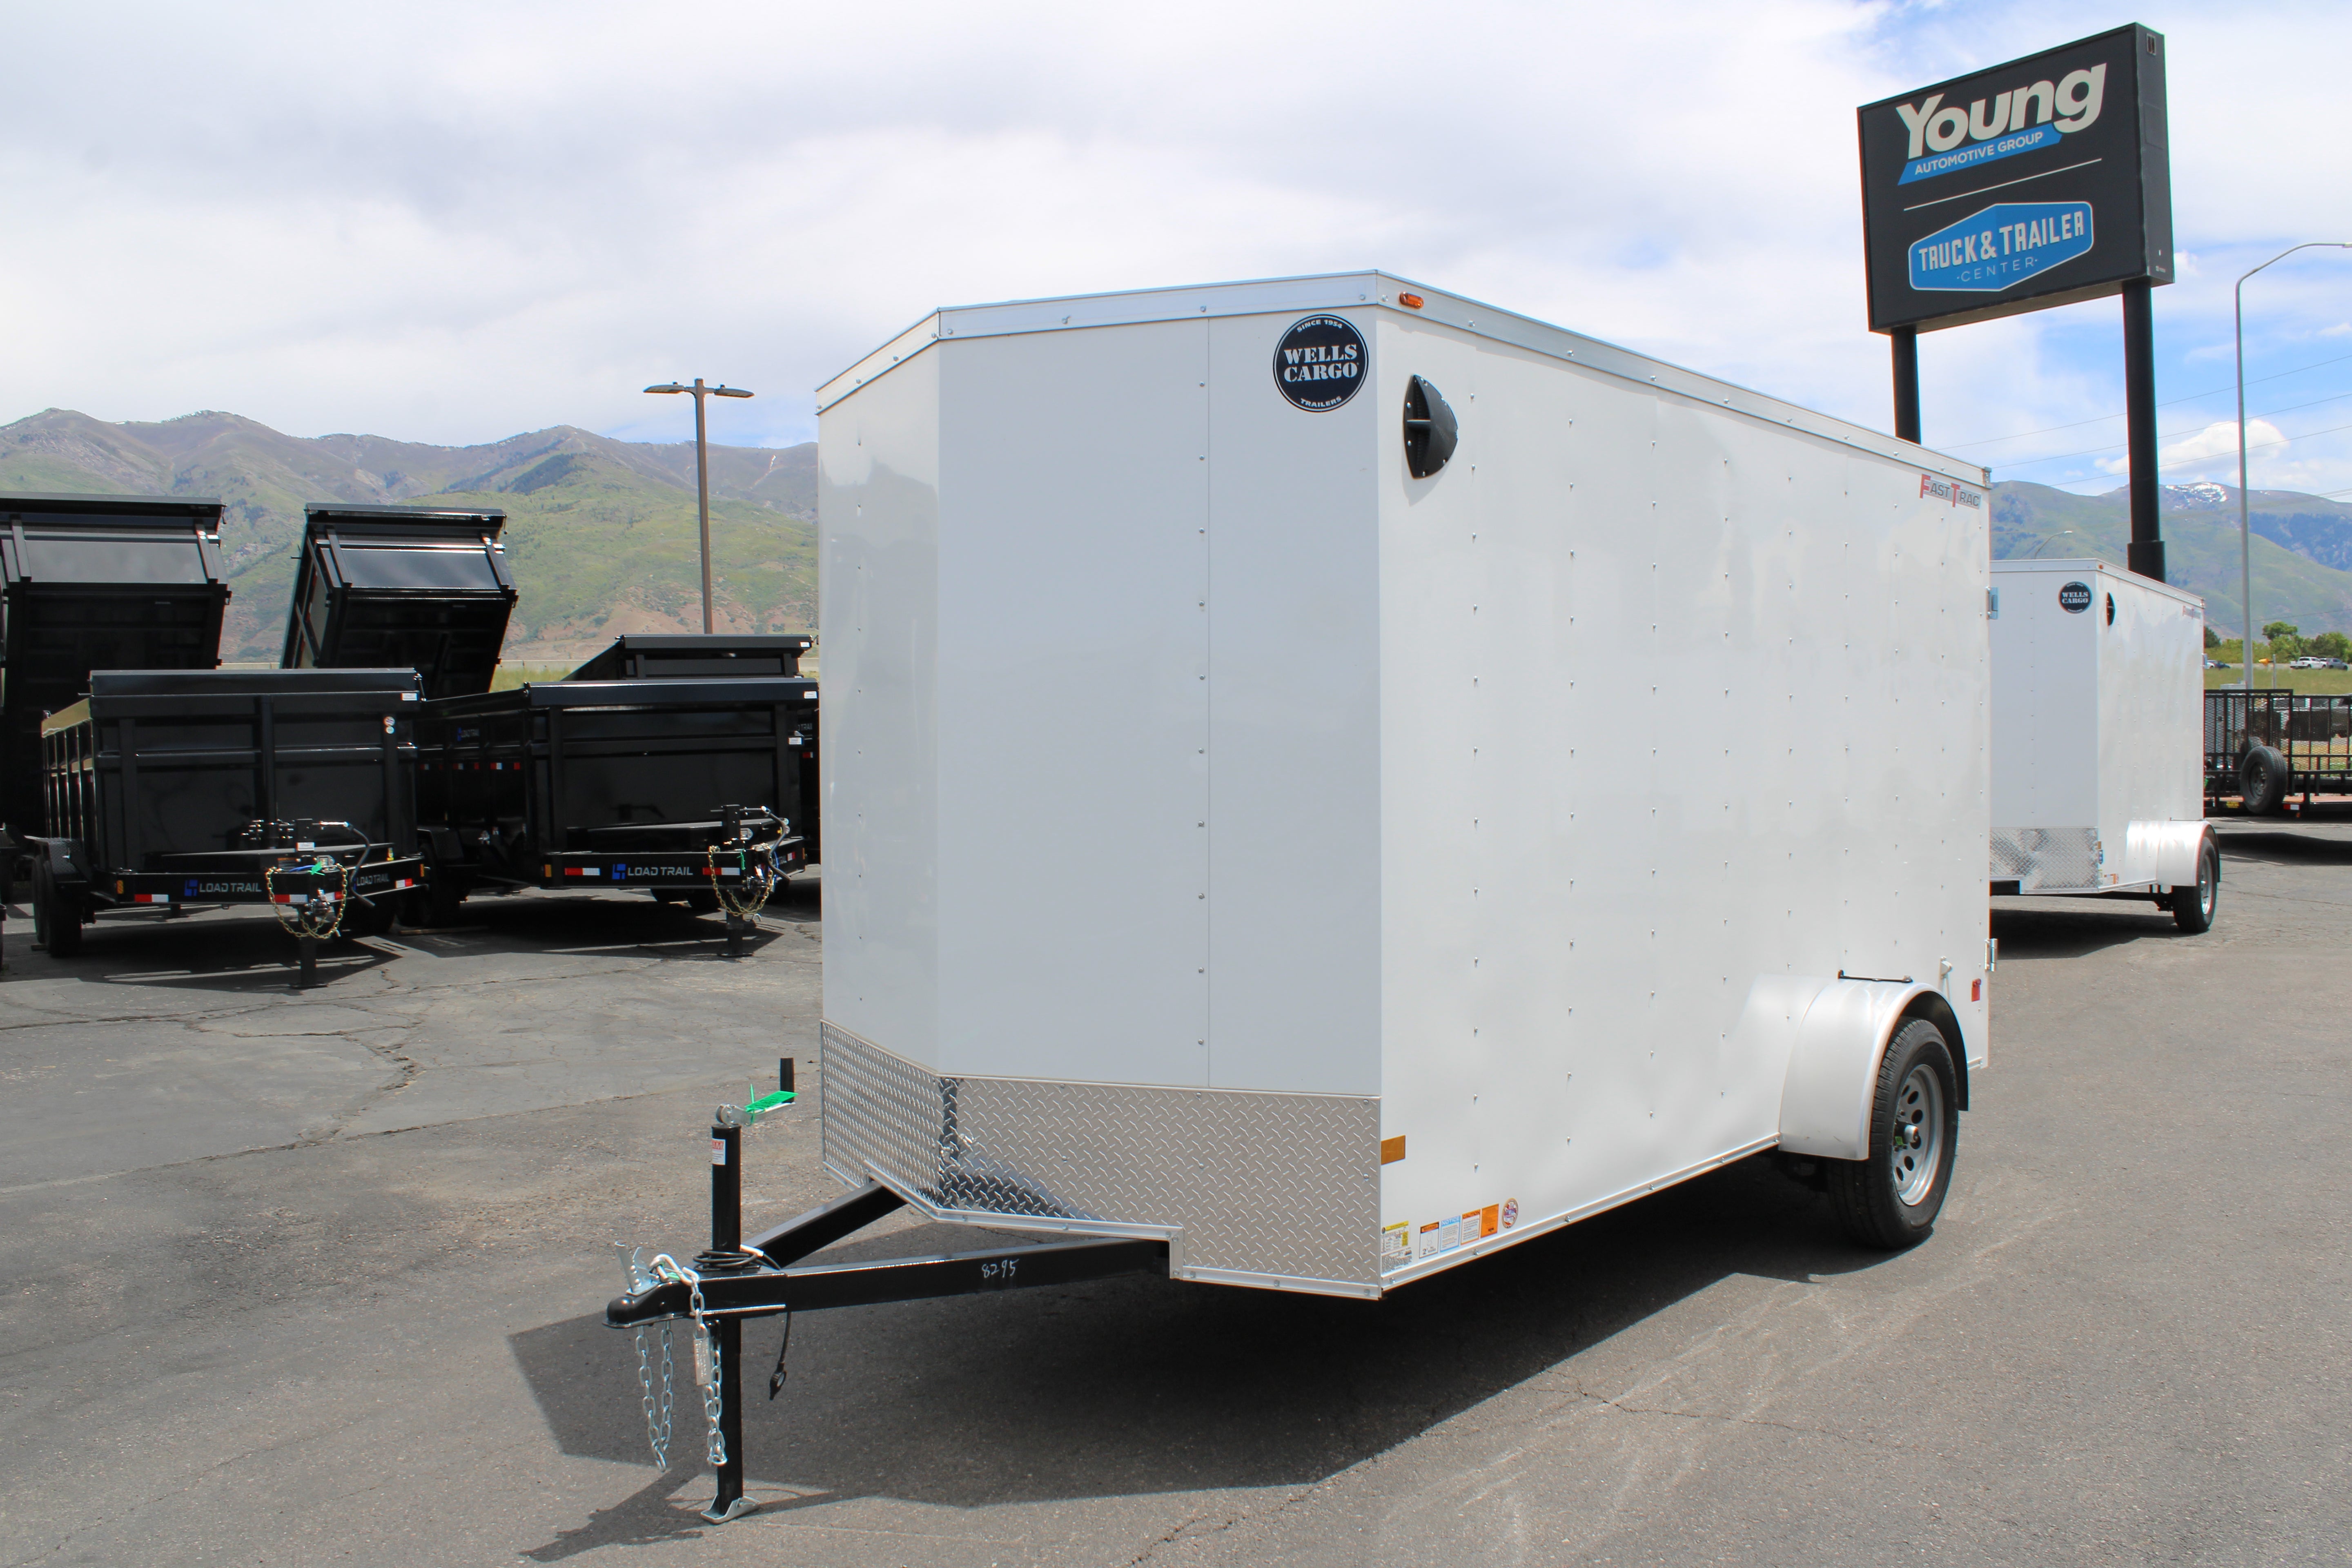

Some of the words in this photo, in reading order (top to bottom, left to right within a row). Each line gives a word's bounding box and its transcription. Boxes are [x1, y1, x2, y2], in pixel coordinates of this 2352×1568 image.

[1895, 62, 2107, 159] Young
[1915, 144, 1995, 176] AUTOMOTIVE
[1998, 131, 2044, 153] GROUP
[1918, 234, 1978, 272] TRUCK
[1999, 211, 2084, 256] TRAILER
[1961, 257, 2035, 282] CENTER
[1296, 319, 1321, 333] SINCE
[1323, 319, 1343, 329] 1954
[1284, 344, 1358, 365] WELLS
[1284, 362, 1358, 383] CARGO
[1300, 396, 1342, 408] TRAILERS
[356, 875, 373, 886] LOAD
[374, 873, 390, 883] TRAIL
[628, 867, 659, 876] LOAD
[660, 866, 693, 875] TRAIL
[199, 883, 229, 892] LOAD
[230, 882, 262, 892] TRAIL
[1441, 1216, 1460, 1225] NOTICE
[1463, 1210, 1481, 1219] CAUTION
[981, 1258, 1020, 1278] 8295
